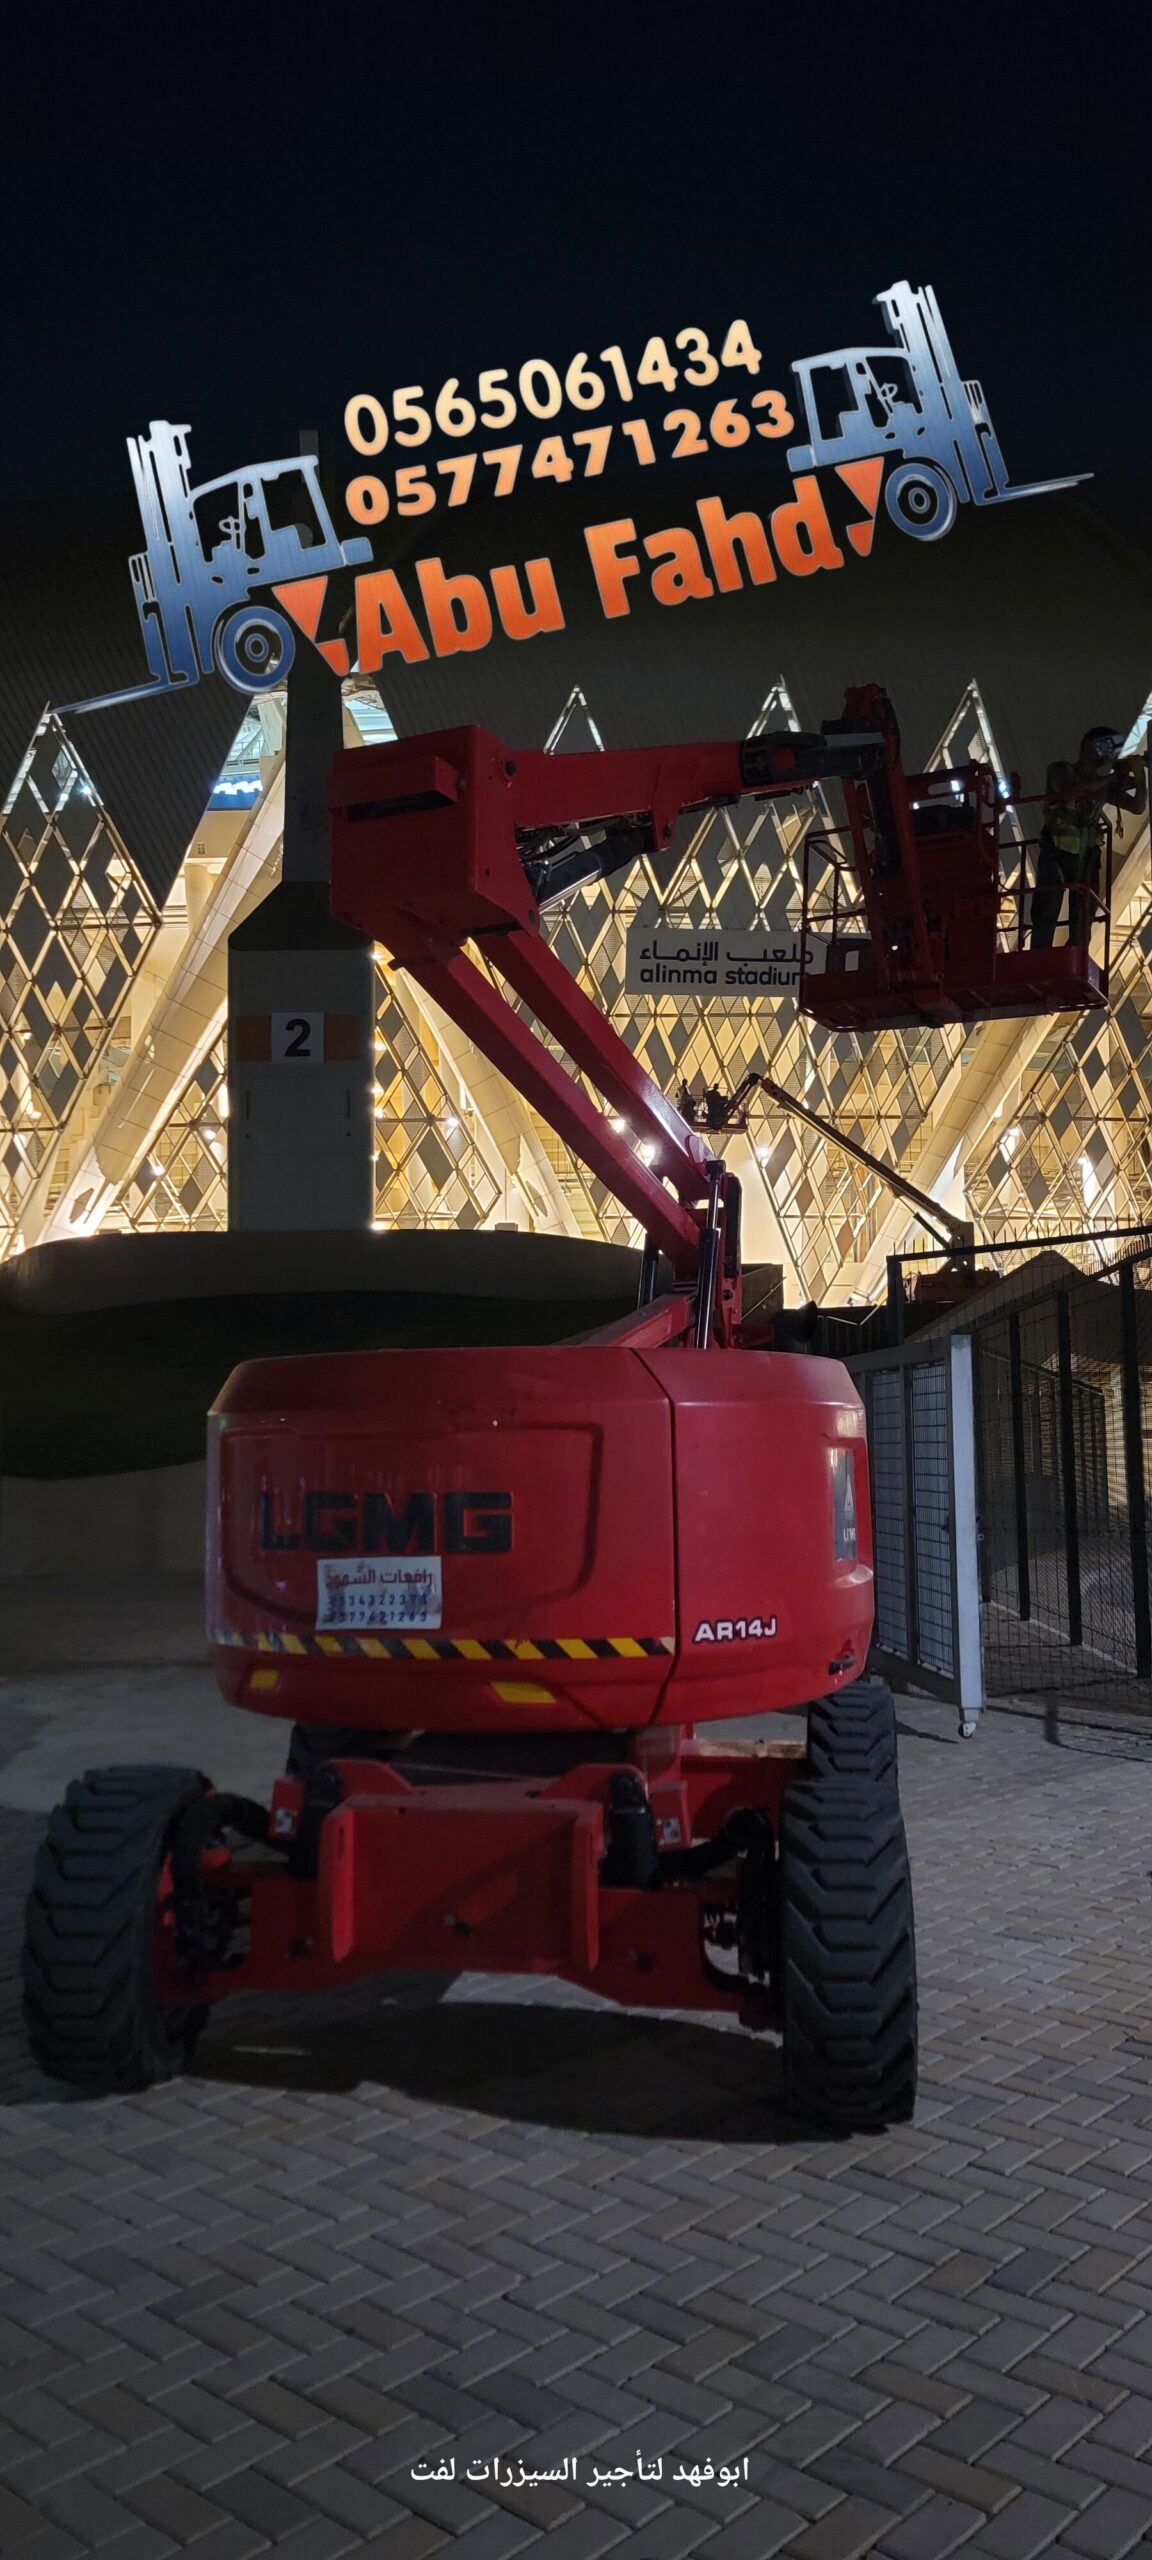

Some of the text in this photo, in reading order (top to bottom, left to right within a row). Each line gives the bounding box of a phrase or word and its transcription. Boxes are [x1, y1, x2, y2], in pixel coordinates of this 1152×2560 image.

[639, 940, 814, 967] ملعب الإنماء
[640, 963, 717, 984] alinma
[284, 1018, 312, 1057] 2
[260, 1491, 513, 1552] LGMG
[693, 1616, 777, 1642] AR14J
